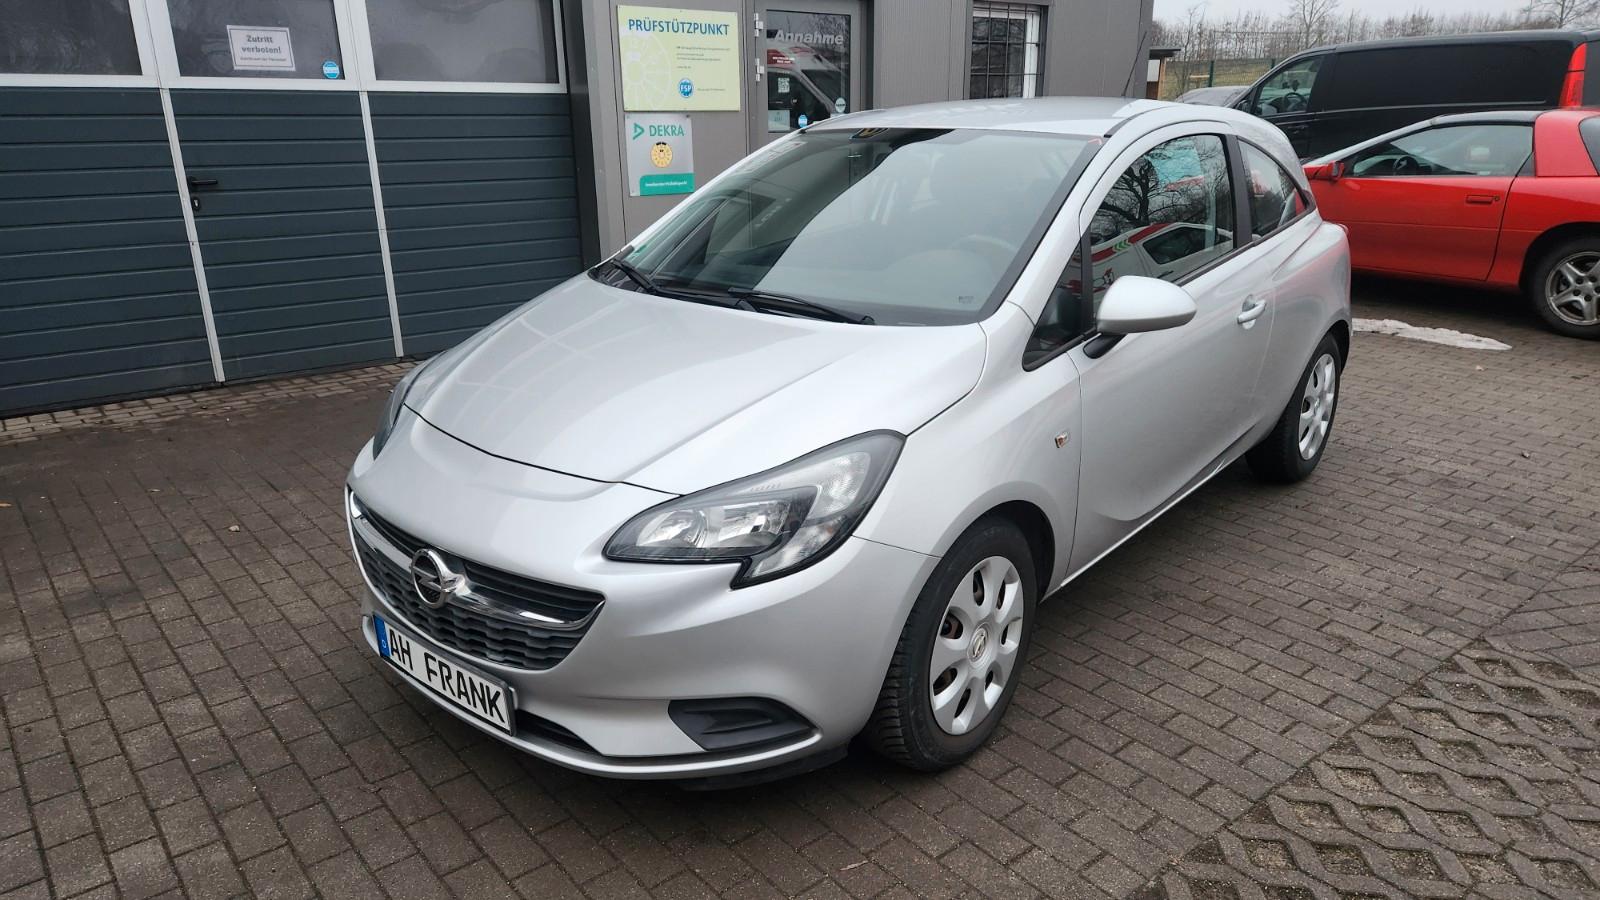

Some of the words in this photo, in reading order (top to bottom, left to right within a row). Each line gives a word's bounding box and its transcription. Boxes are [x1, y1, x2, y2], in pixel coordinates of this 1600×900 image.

[628, 17, 729, 35] PRÜFSTÜTZPUNKT
[246, 35, 273, 43] Zutritt
[774, 29, 844, 45] Annahme
[241, 46, 281, 54] verboten!
[649, 125, 684, 136] DEKRA
[388, 628, 414, 671] AH
[424, 651, 506, 723] FRANK
